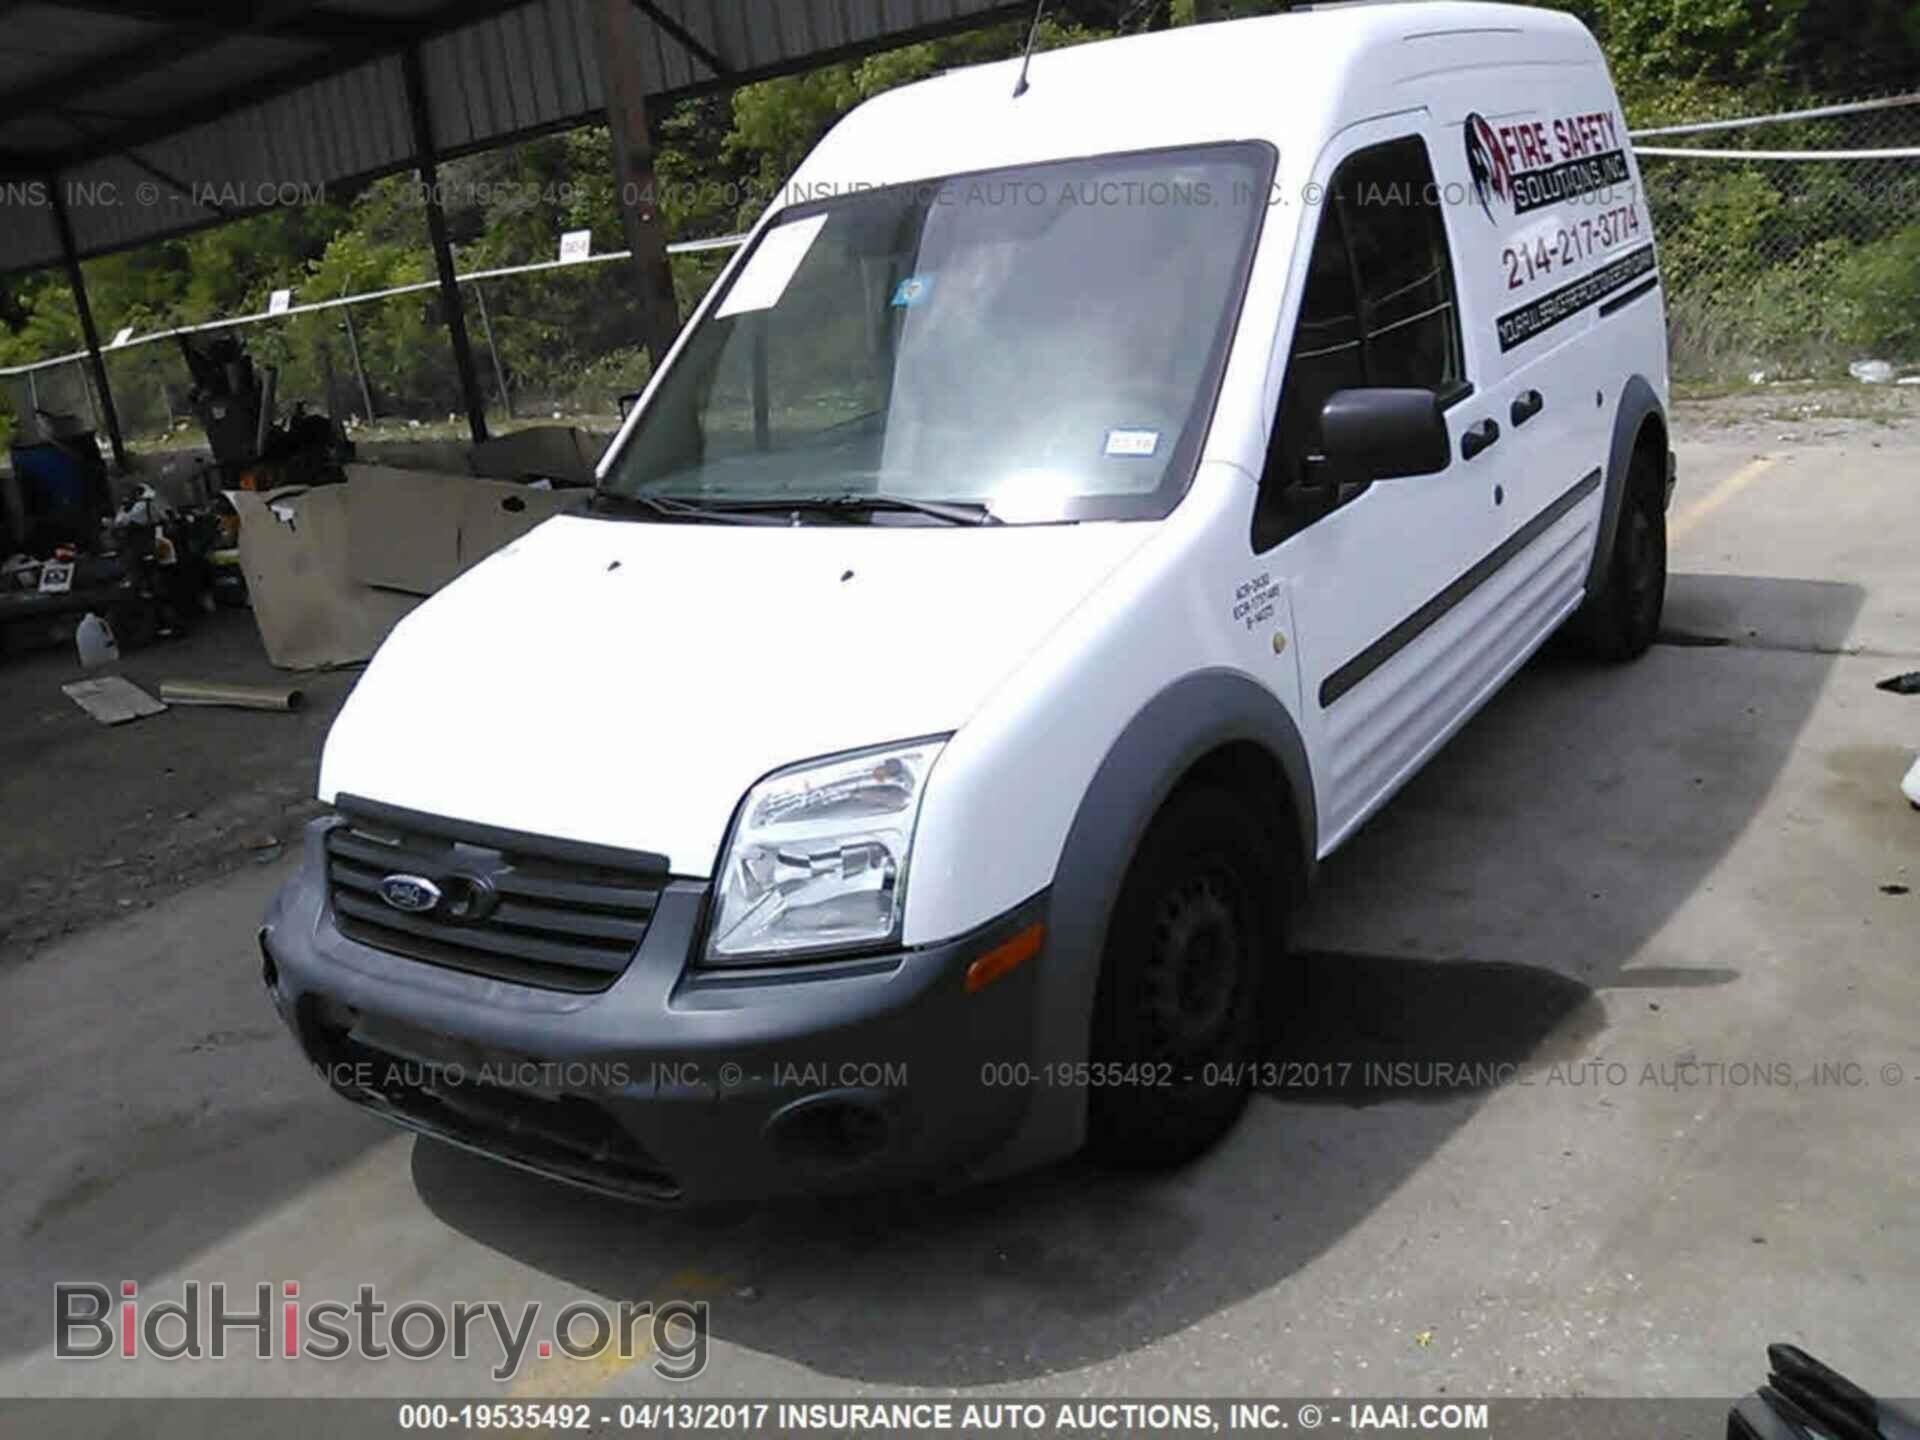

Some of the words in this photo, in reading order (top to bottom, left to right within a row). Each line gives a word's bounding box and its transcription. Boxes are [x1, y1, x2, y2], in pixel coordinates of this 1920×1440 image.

[1499, 122, 1552, 172] FIRE
[1553, 111, 1618, 159] SAFETY
[1513, 160, 1601, 207] SOLUTIONS
[1503, 204, 1639, 290] 214-217-3774
